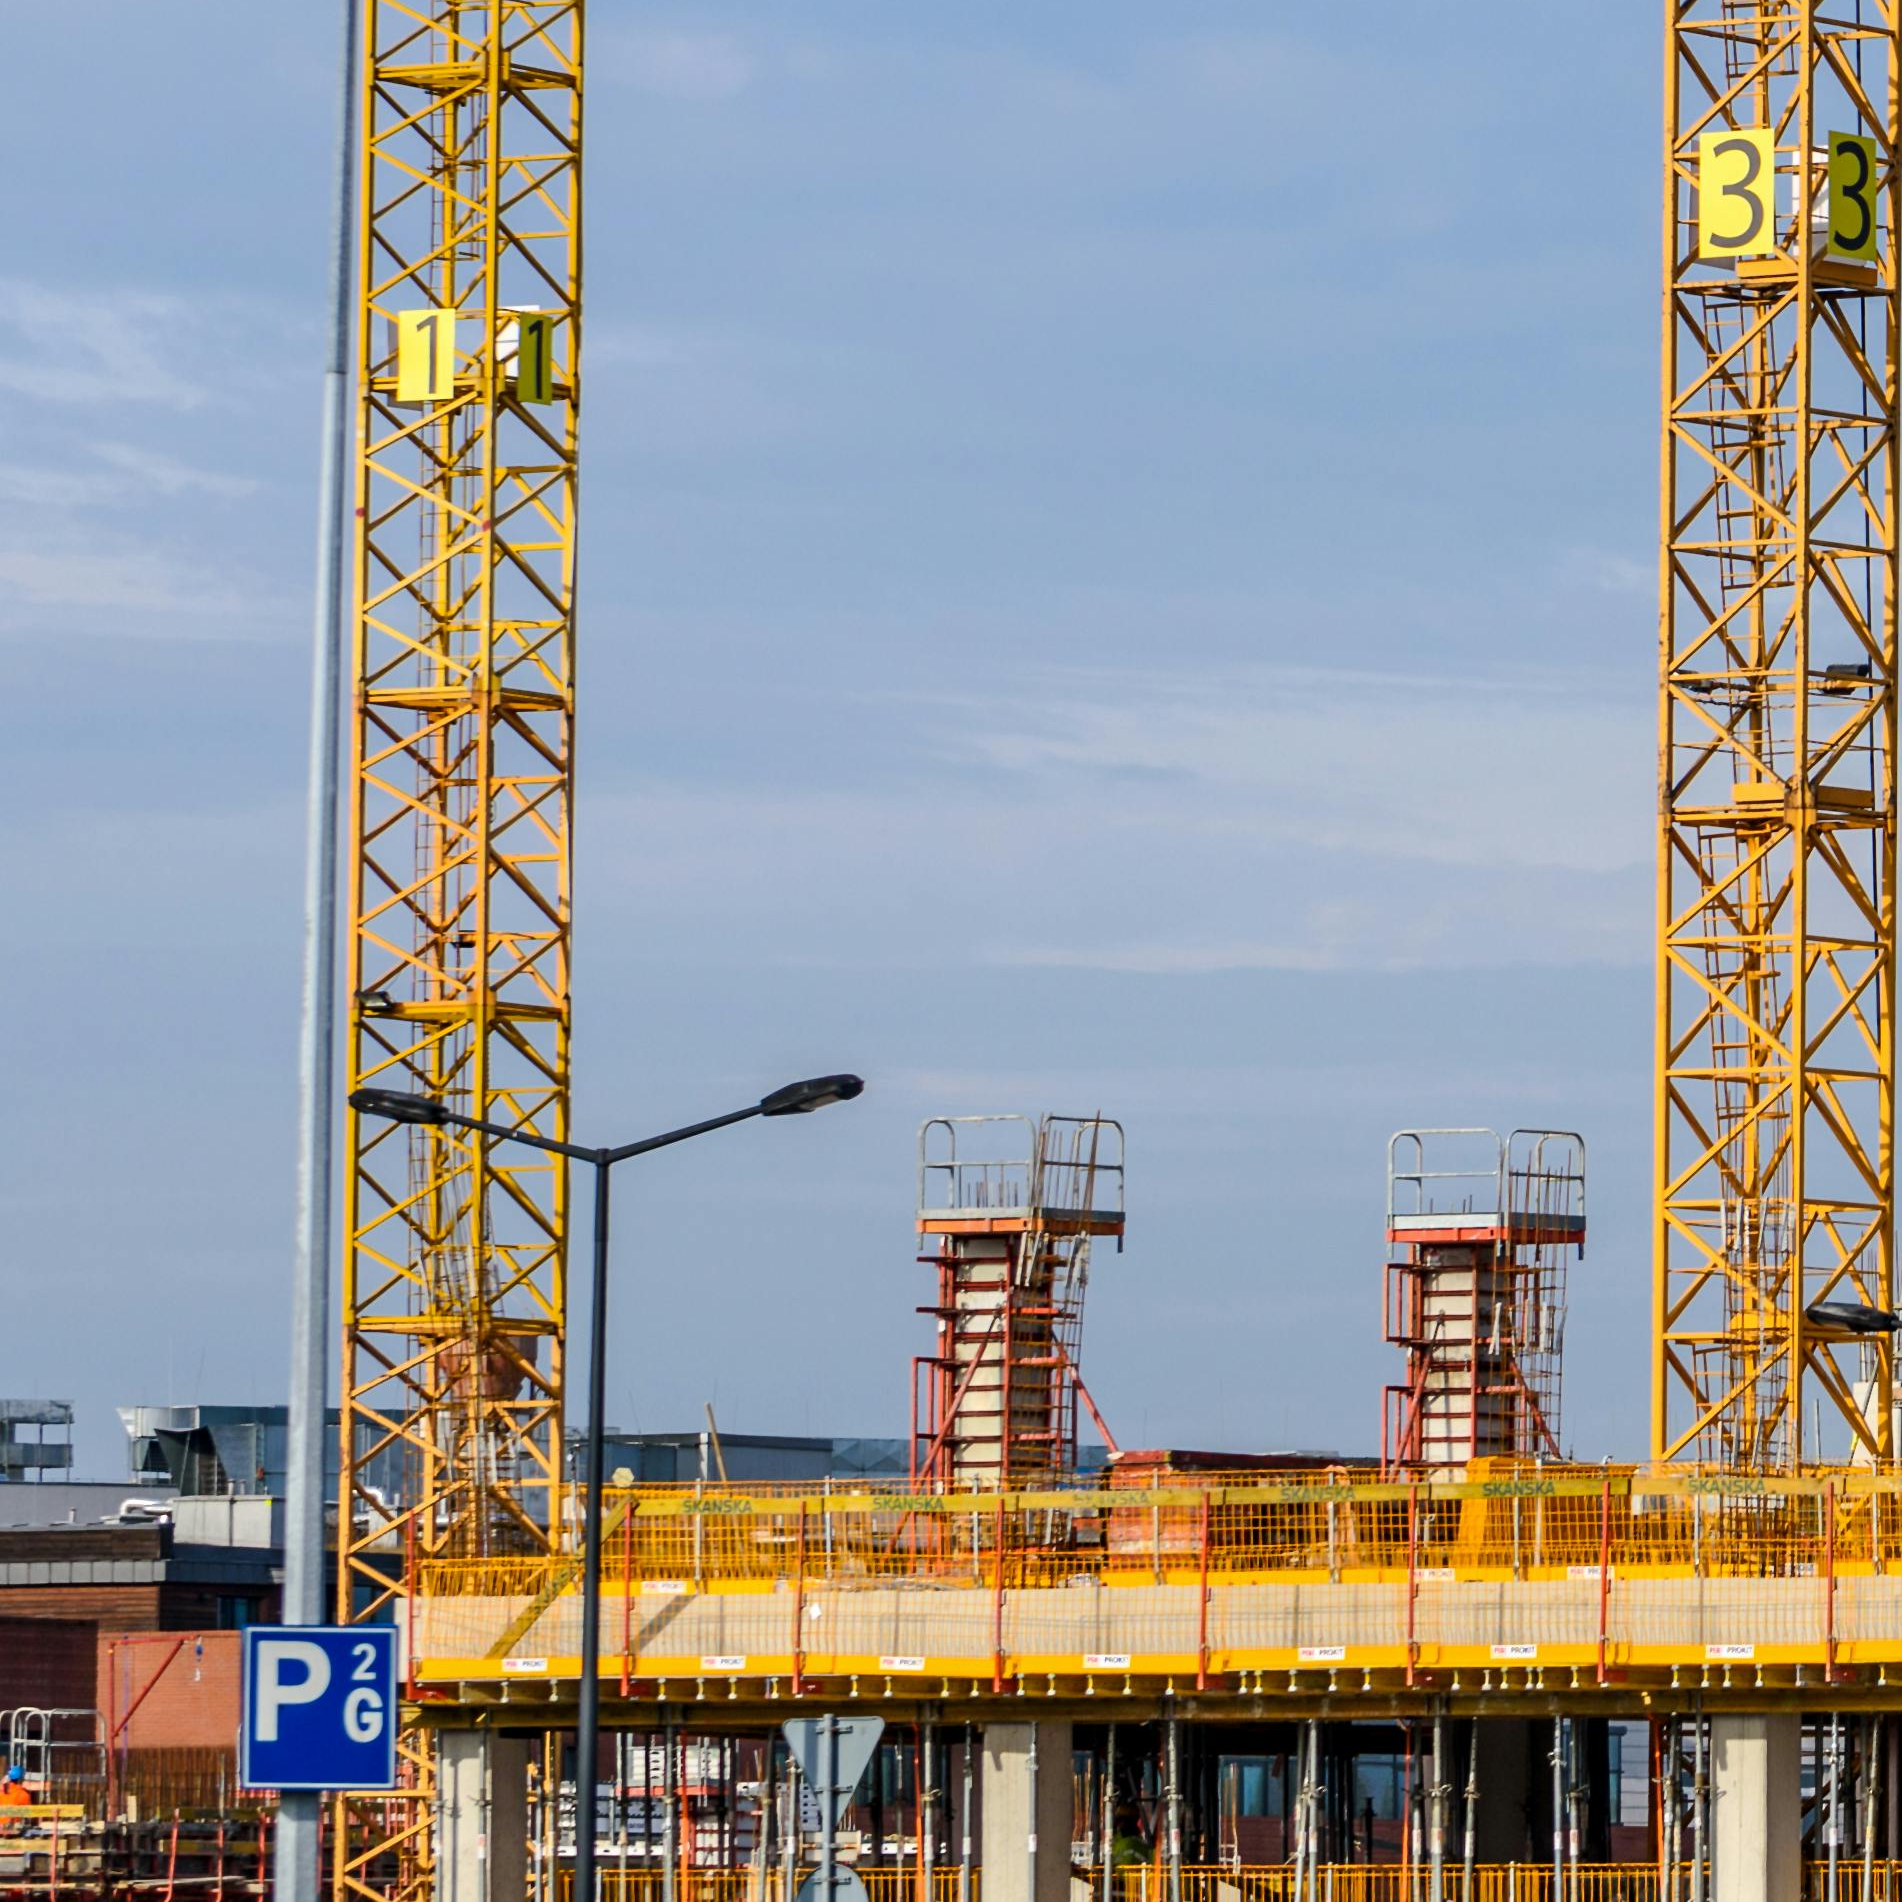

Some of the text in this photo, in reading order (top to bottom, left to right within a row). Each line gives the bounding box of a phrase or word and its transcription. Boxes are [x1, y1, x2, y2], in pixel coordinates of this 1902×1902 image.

[1709, 138, 1764, 248] 3
[1834, 140, 1871, 251] 3
[416, 315, 438, 394] 1
[528, 319, 543, 399] 1
[682, 1499, 753, 1513] SKANSKA
[873, 1497, 945, 1511] SKANSKA
[1281, 1486, 1356, 1501] SKANSKA
[1482, 1482, 1556, 1496] SKANSKA
[1688, 1479, 1766, 1494] SKANSKA
[351, 1643, 377, 1681] 2
[255, 1640, 331, 1742] P
[343, 1687, 383, 1743] G
